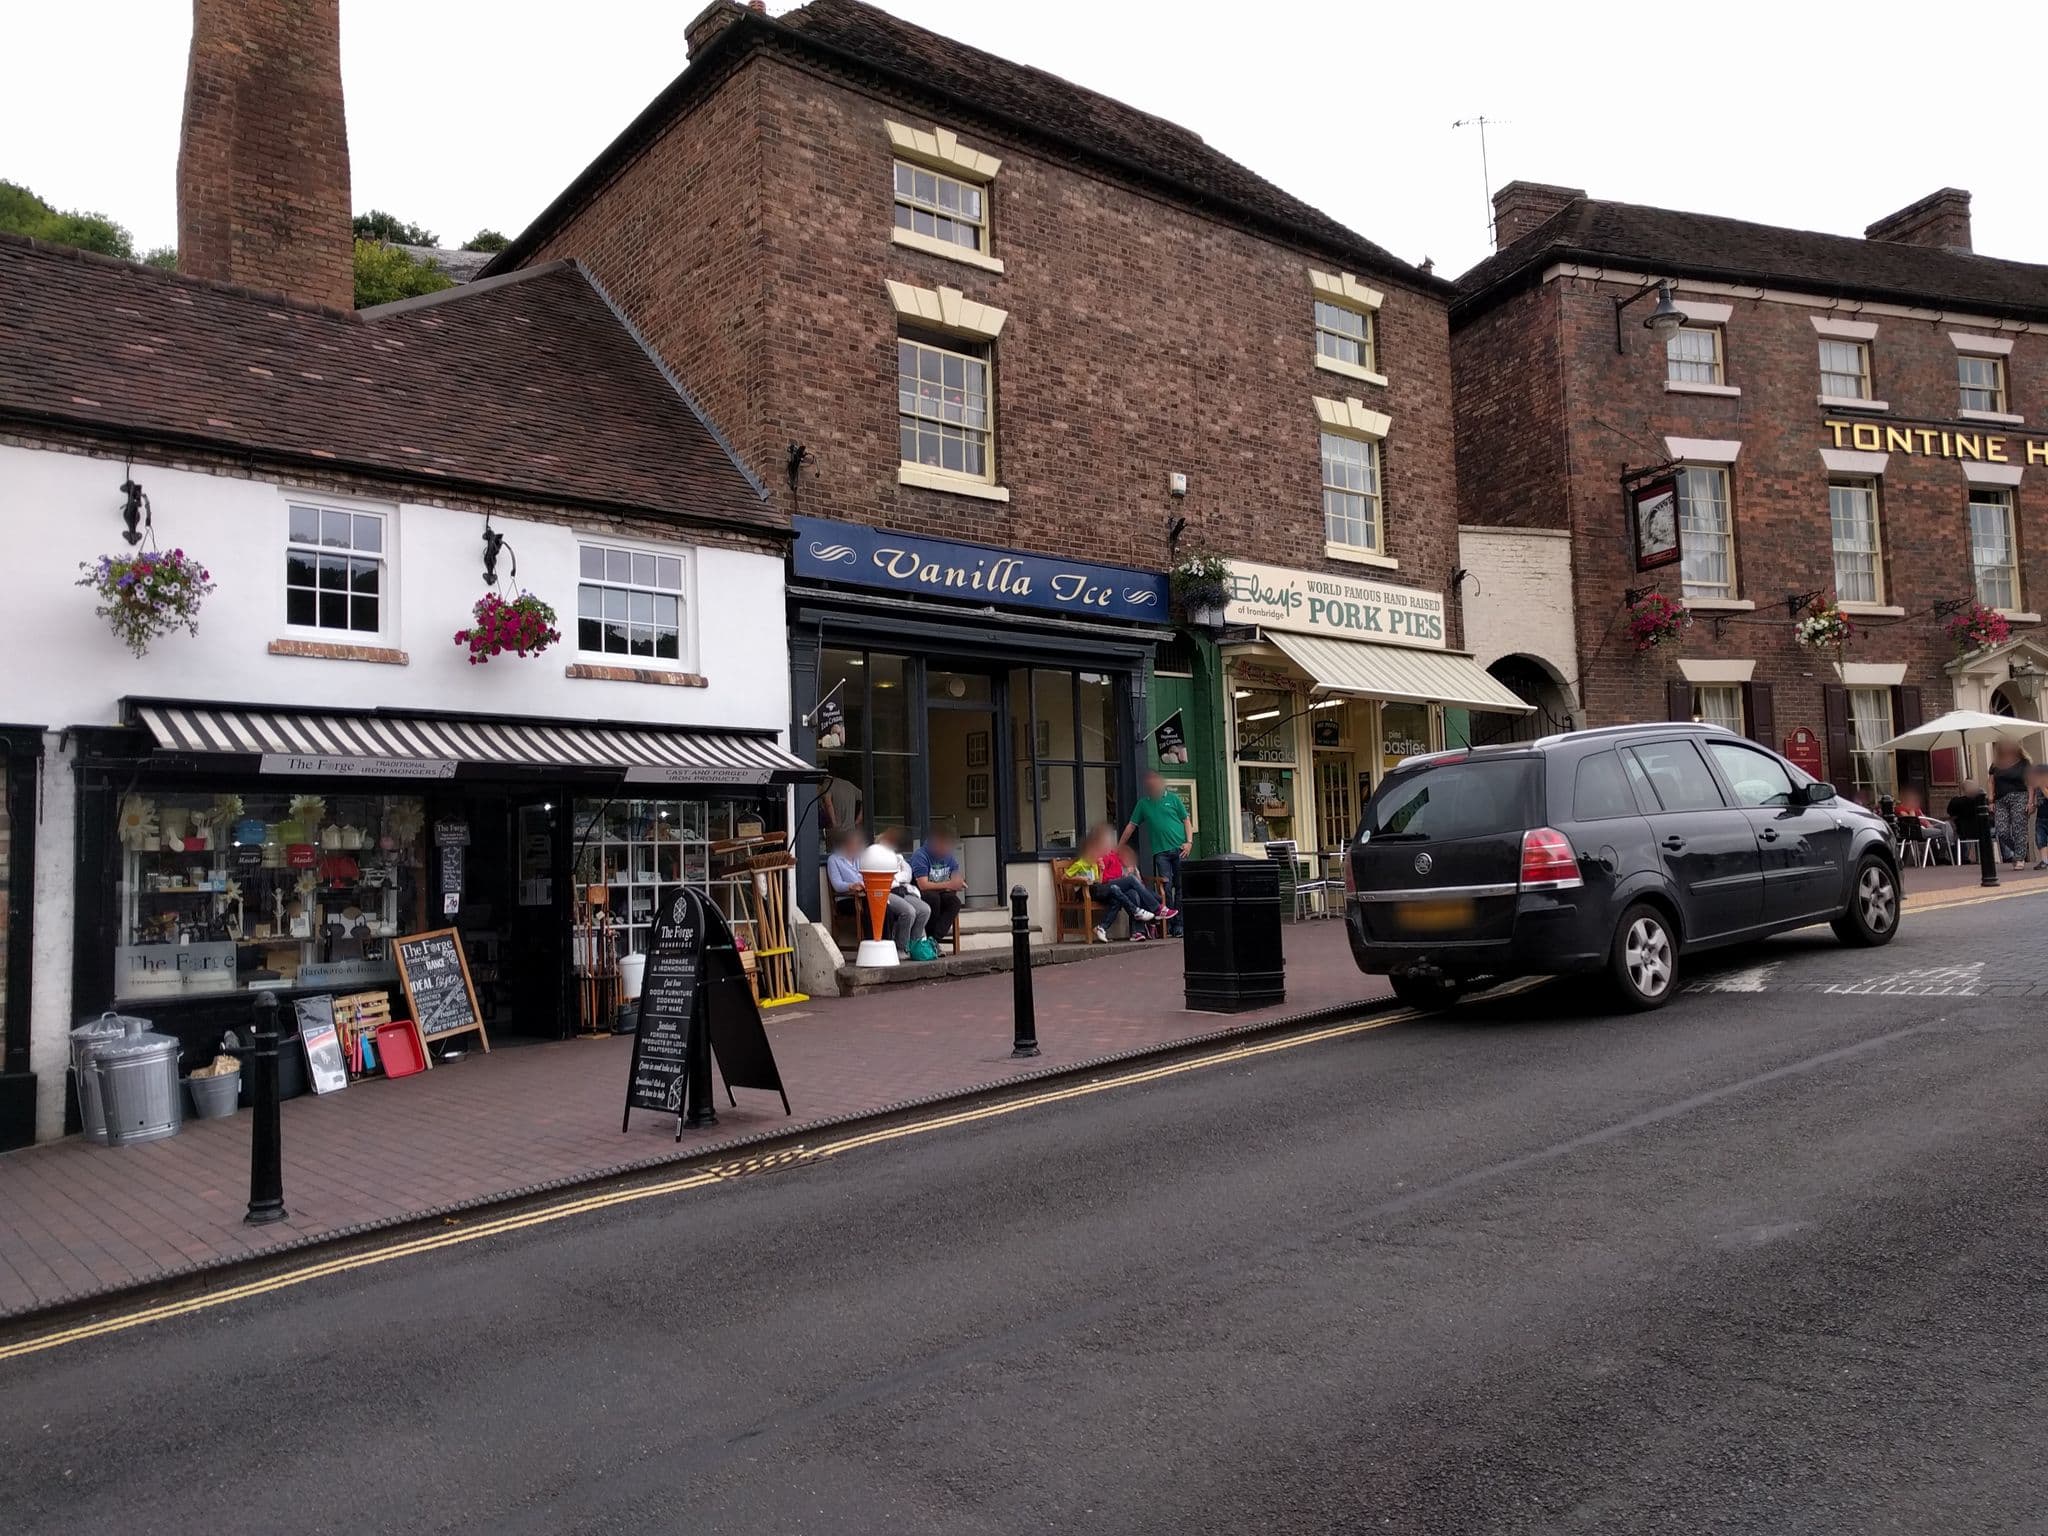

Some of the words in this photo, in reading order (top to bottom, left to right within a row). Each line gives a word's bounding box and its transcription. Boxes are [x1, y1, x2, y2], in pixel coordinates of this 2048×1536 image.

[1824, 420, 2009, 462] TONTINE
[873, 548, 1033, 596] Vanilla
[1051, 573, 1113, 606] Ice
[1307, 581, 1342, 596] WORLD
[1344, 586, 1382, 602] FAMOUS
[1383, 592, 1408, 606] HAND
[1410, 596, 1440, 611] RAISED
[1246, 607, 1284, 620] Ironbridge
[1308, 597, 1383, 632] PORK
[1388, 608, 1442, 640] PIES
[1240, 731, 1288, 748] pastie
[1384, 739, 1426, 756] pasties
[288, 758, 313, 770] The
[375, 760, 426, 768] TRADITIONAL
[390, 768, 436, 776] MONGERS
[661, 926, 674, 938] The
[674, 926, 694, 942] Forge
[400, 944, 422, 959] The
[301, 967, 344, 976] Hardware
[410, 978, 434, 992] IDEAL
[641, 1038, 666, 1046] PRODUCTS
